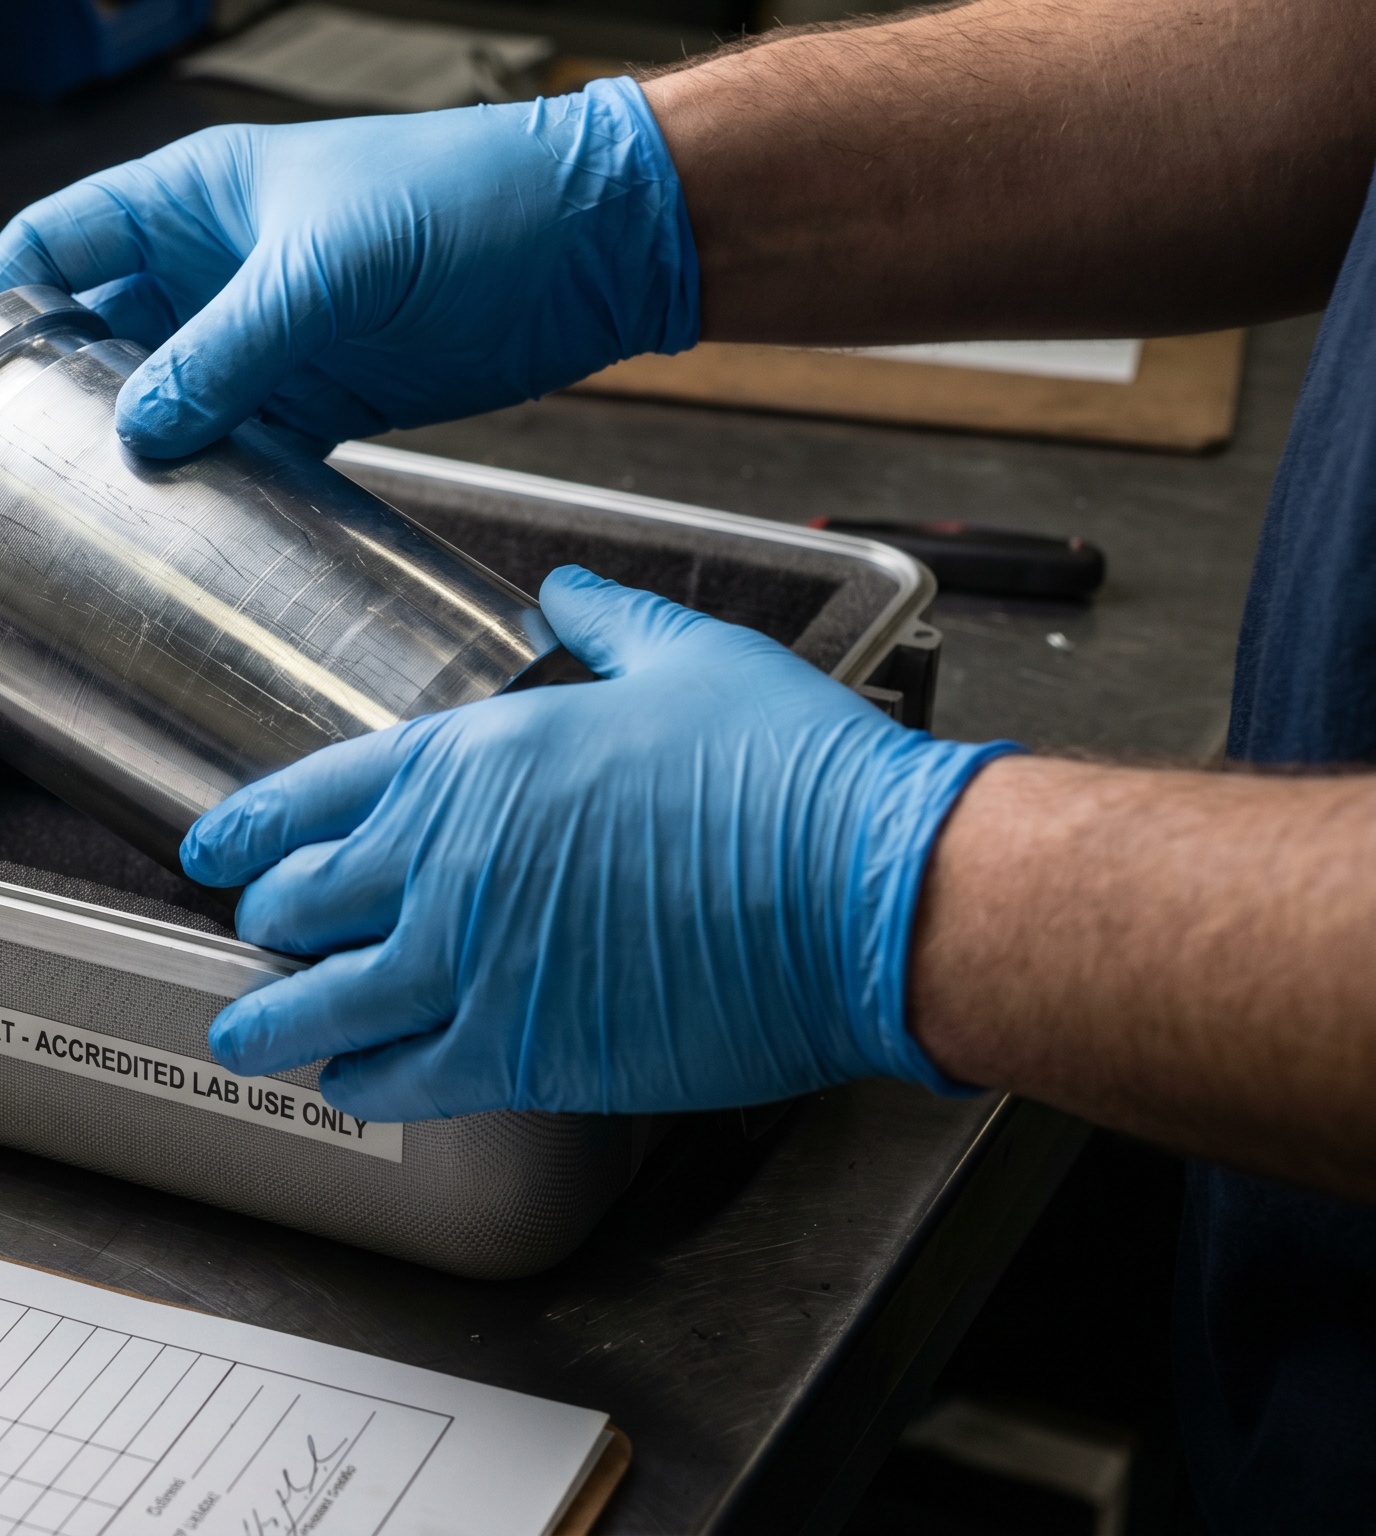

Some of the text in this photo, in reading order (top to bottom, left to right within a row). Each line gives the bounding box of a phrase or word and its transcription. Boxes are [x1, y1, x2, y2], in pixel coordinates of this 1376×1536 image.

[34, 1030, 185, 1090] ACCREDITED
[193, 1071, 240, 1105] LAB
[247, 1085, 295, 1121] USE
[302, 1102, 368, 1139] ONLY
